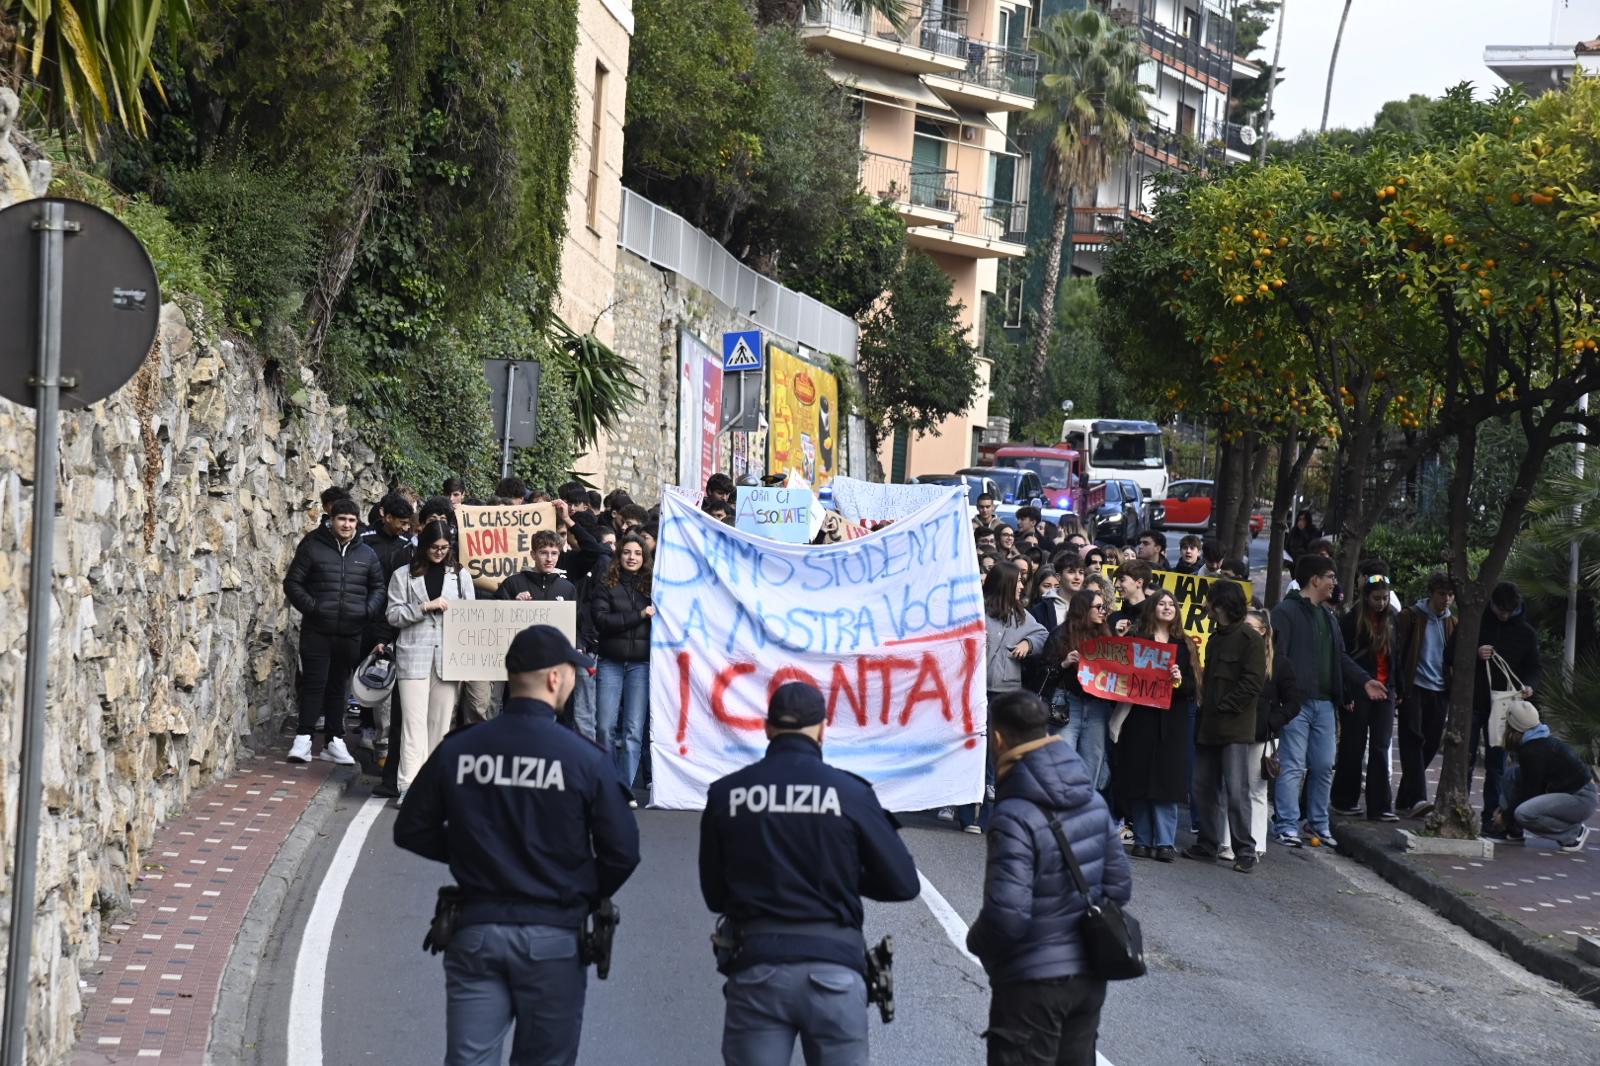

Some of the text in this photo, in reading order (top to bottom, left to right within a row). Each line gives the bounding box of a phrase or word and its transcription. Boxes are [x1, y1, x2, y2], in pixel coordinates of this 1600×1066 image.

[466, 528, 530, 557] NON È
[801, 510, 960, 592] STUDENTI
[451, 607, 485, 623] PRIMA
[493, 607, 504, 623] DI
[652, 574, 981, 654] LA NOSTRA VOCE
[1133, 643, 1172, 671] VALE
[1094, 669, 1129, 697] CHE
[456, 753, 566, 791] POLIZIA
[729, 784, 842, 817] POLIZIA
